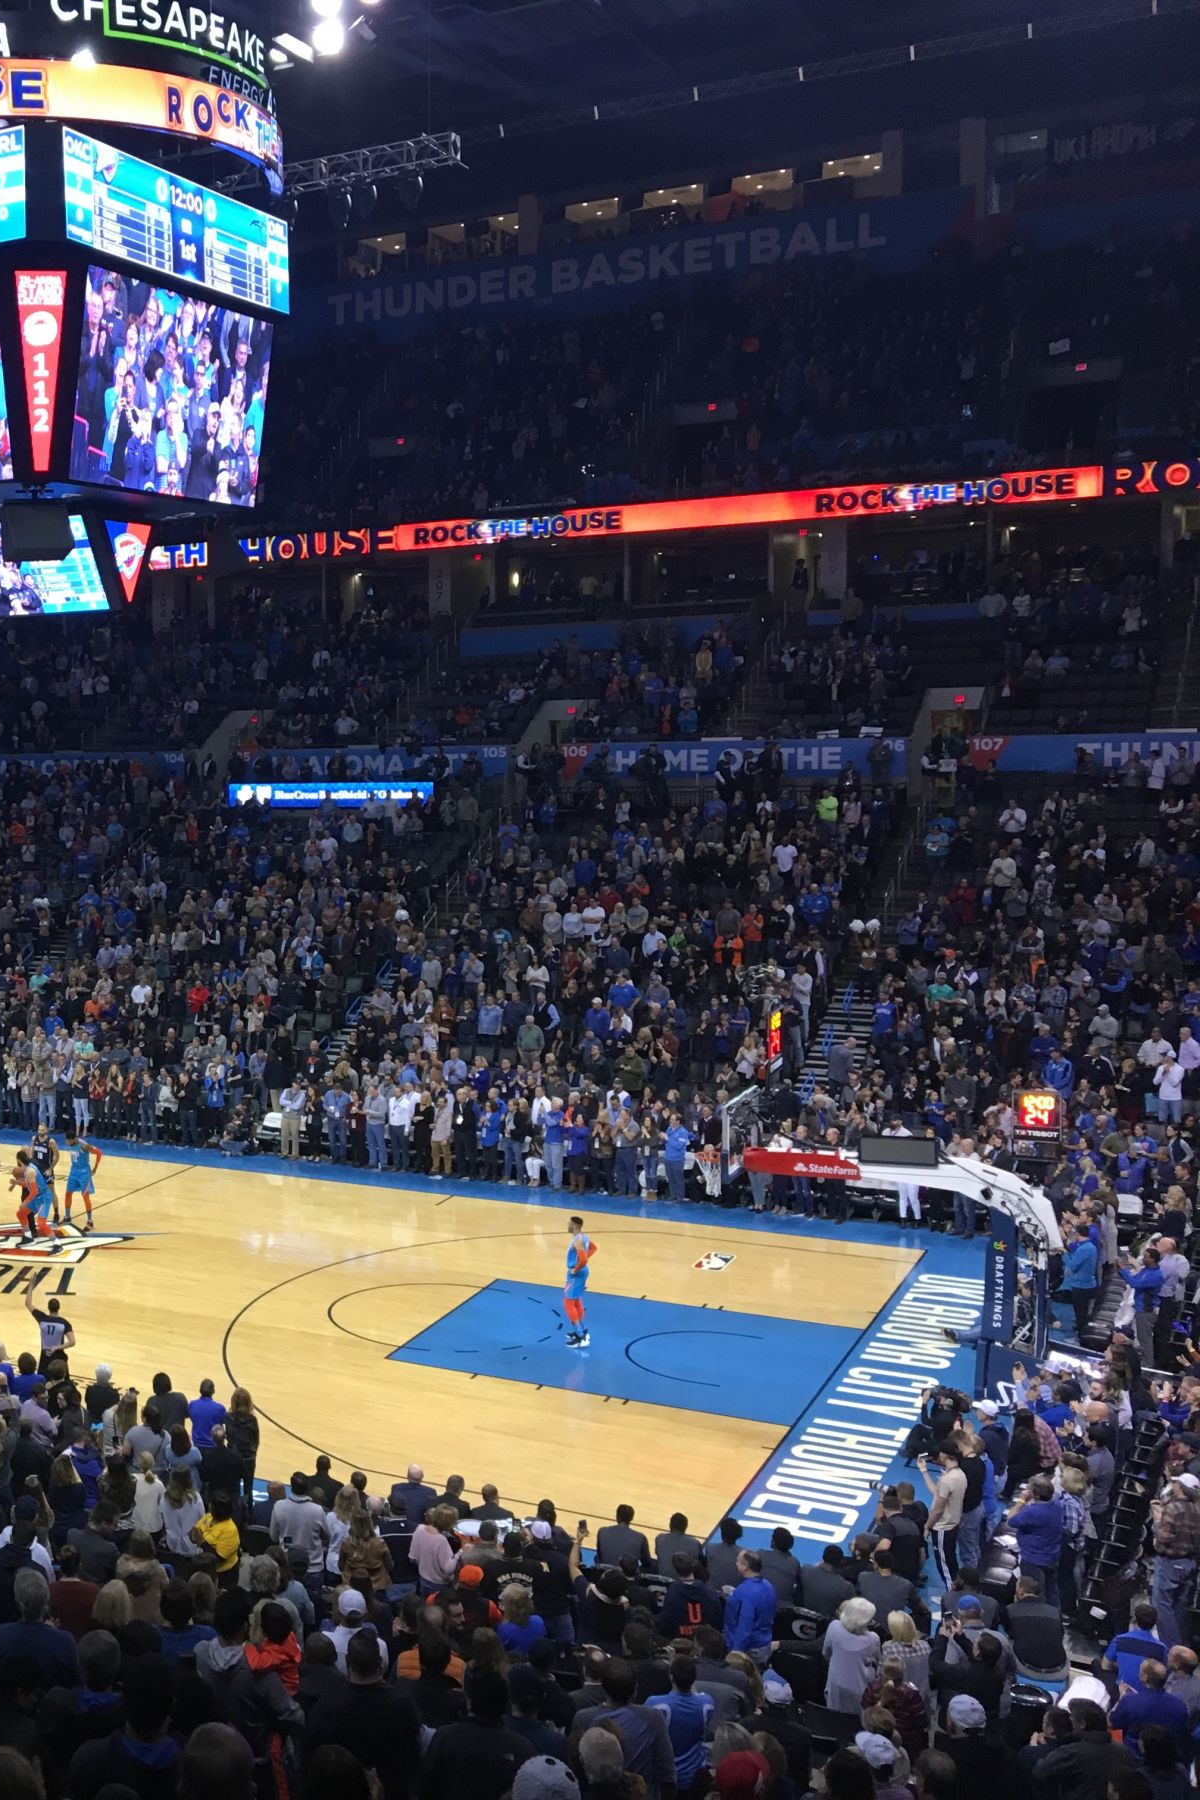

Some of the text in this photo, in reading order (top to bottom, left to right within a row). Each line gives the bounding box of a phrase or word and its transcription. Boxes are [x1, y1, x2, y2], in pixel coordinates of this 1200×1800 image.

[208, 66, 266, 104] ENERGY
[167, 86, 251, 133] ROCK
[64, 135, 91, 160] OKC
[156, 176, 168, 203] 0
[170, 185, 203, 215] 12:00
[206, 198, 217, 222] 0
[180, 239, 197, 262] 1st
[328, 263, 538, 327] THUNDER
[550, 212, 888, 297] BASKETBALL
[815, 473, 1075, 514] ROCK THE HOUSE
[413, 511, 622, 546] ROCK THE HOUSE
[240, 528, 397, 562] HOUSE
[483, 747, 507, 758] 105
[562, 745, 588, 758] 106
[972, 738, 1004, 751] 107
[164, 753, 185, 764] 104
[616, 748, 709, 772] HME
[780, 746, 843, 771] THE
[1025, 1108, 1049, 1125] 24
[1028, 1131, 1059, 1139] TISSOT
[992, 1255, 1005, 1329] DRAFTKINGS
[46, 1324, 56, 1336] 17
[738, 1273, 986, 1544] OKLAHOMA CITY THUNDER
